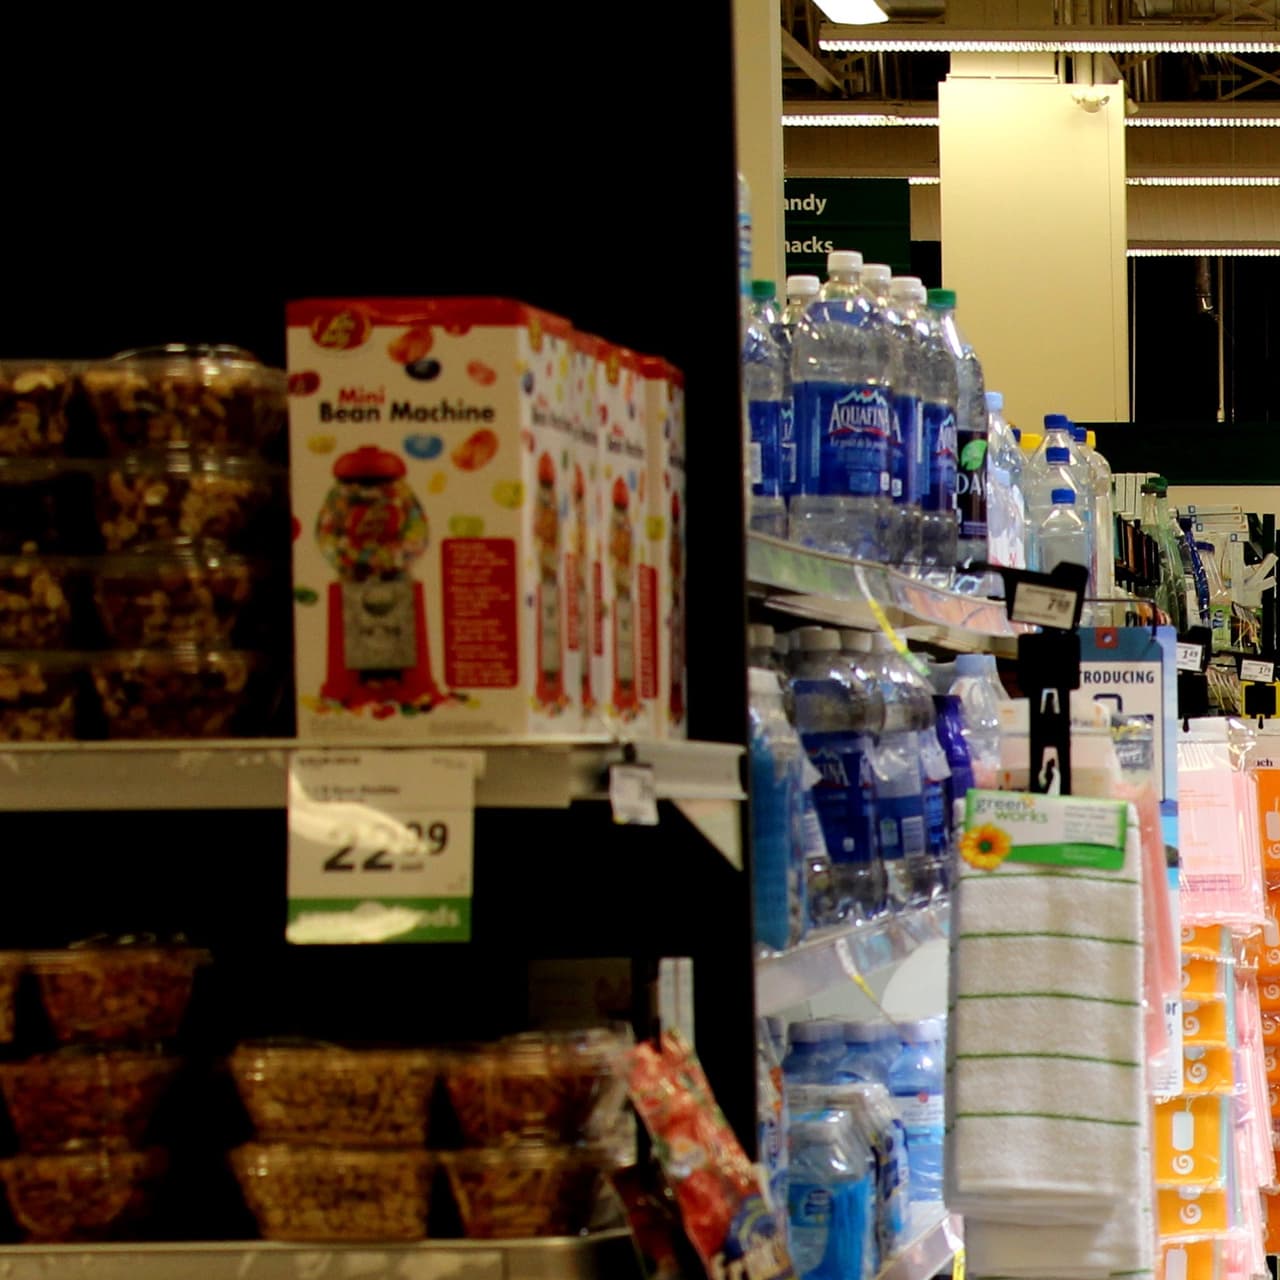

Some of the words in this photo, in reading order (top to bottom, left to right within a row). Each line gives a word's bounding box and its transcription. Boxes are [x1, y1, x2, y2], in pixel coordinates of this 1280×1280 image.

[784, 194, 827, 215] andy
[784, 236, 833, 254] nacks
[339, 387, 385, 404] Mini
[319, 403, 381, 424] Bean
[389, 401, 495, 423] Machine
[1081, 670, 1155, 684] RODUCING
